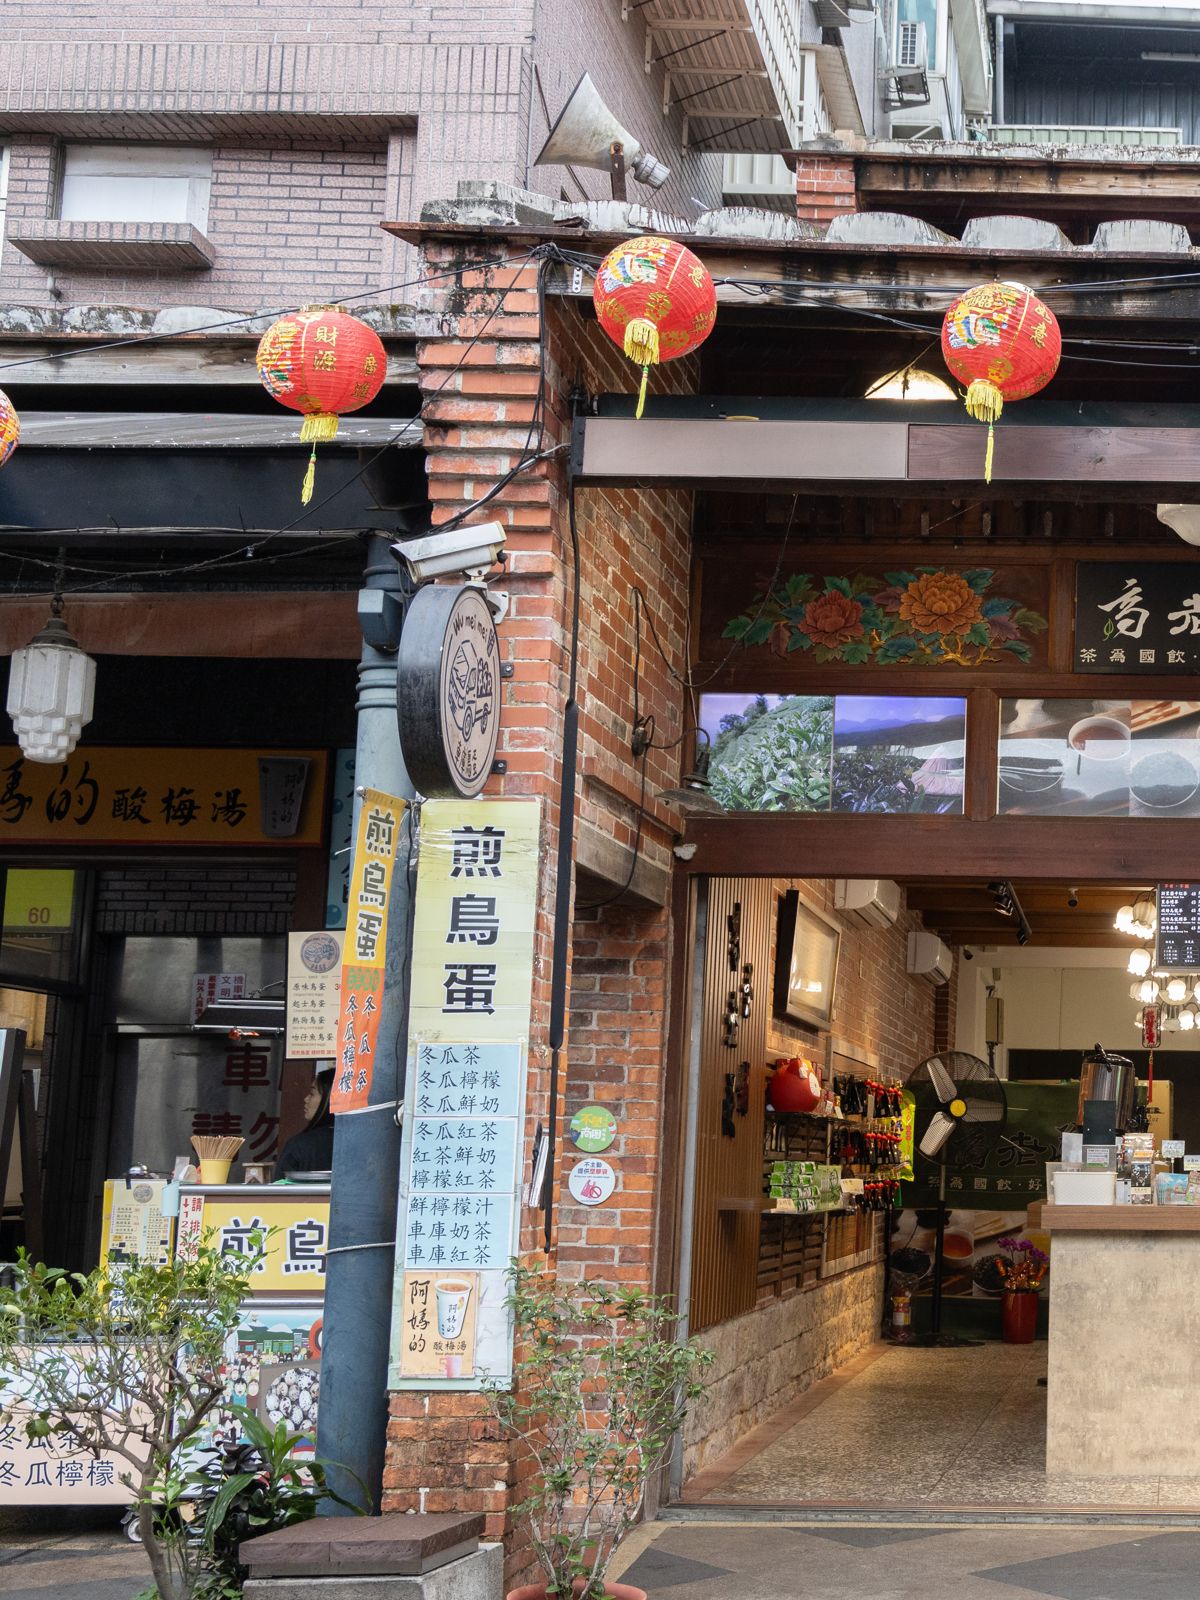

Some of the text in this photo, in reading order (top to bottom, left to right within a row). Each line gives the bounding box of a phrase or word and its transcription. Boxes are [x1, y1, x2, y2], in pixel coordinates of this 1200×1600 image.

[314, 326, 339, 371] 財源
[453, 614, 464, 637] Wu
[465, 613, 478, 631] mei
[477, 622, 488, 644] mei
[357, 807, 397, 960] 煎鳥蛋
[28, 907, 50, 925] 60
[442, 825, 506, 1016] 煎鳥蛋
[420, 1046, 481, 1065] 冬瓜茶
[418, 1070, 501, 1090] 冬瓜檸檬
[417, 1094, 500, 1114] 冬瓜鮮奶
[416, 1121, 498, 1142] 冬瓜紅茶
[412, 1146, 497, 1166] 紅茶鮮奶
[411, 1169, 496, 1189] 檸檬紅茶
[409, 1197, 494, 1217] 鮮檸檬汁
[407, 1220, 492, 1241] 車庫奶茶
[407, 1244, 492, 1265] 車庫紅茶
[407, 1279, 431, 1353] 阿媽的
[0, 1460, 114, 1487] 冬瓜檸檬
